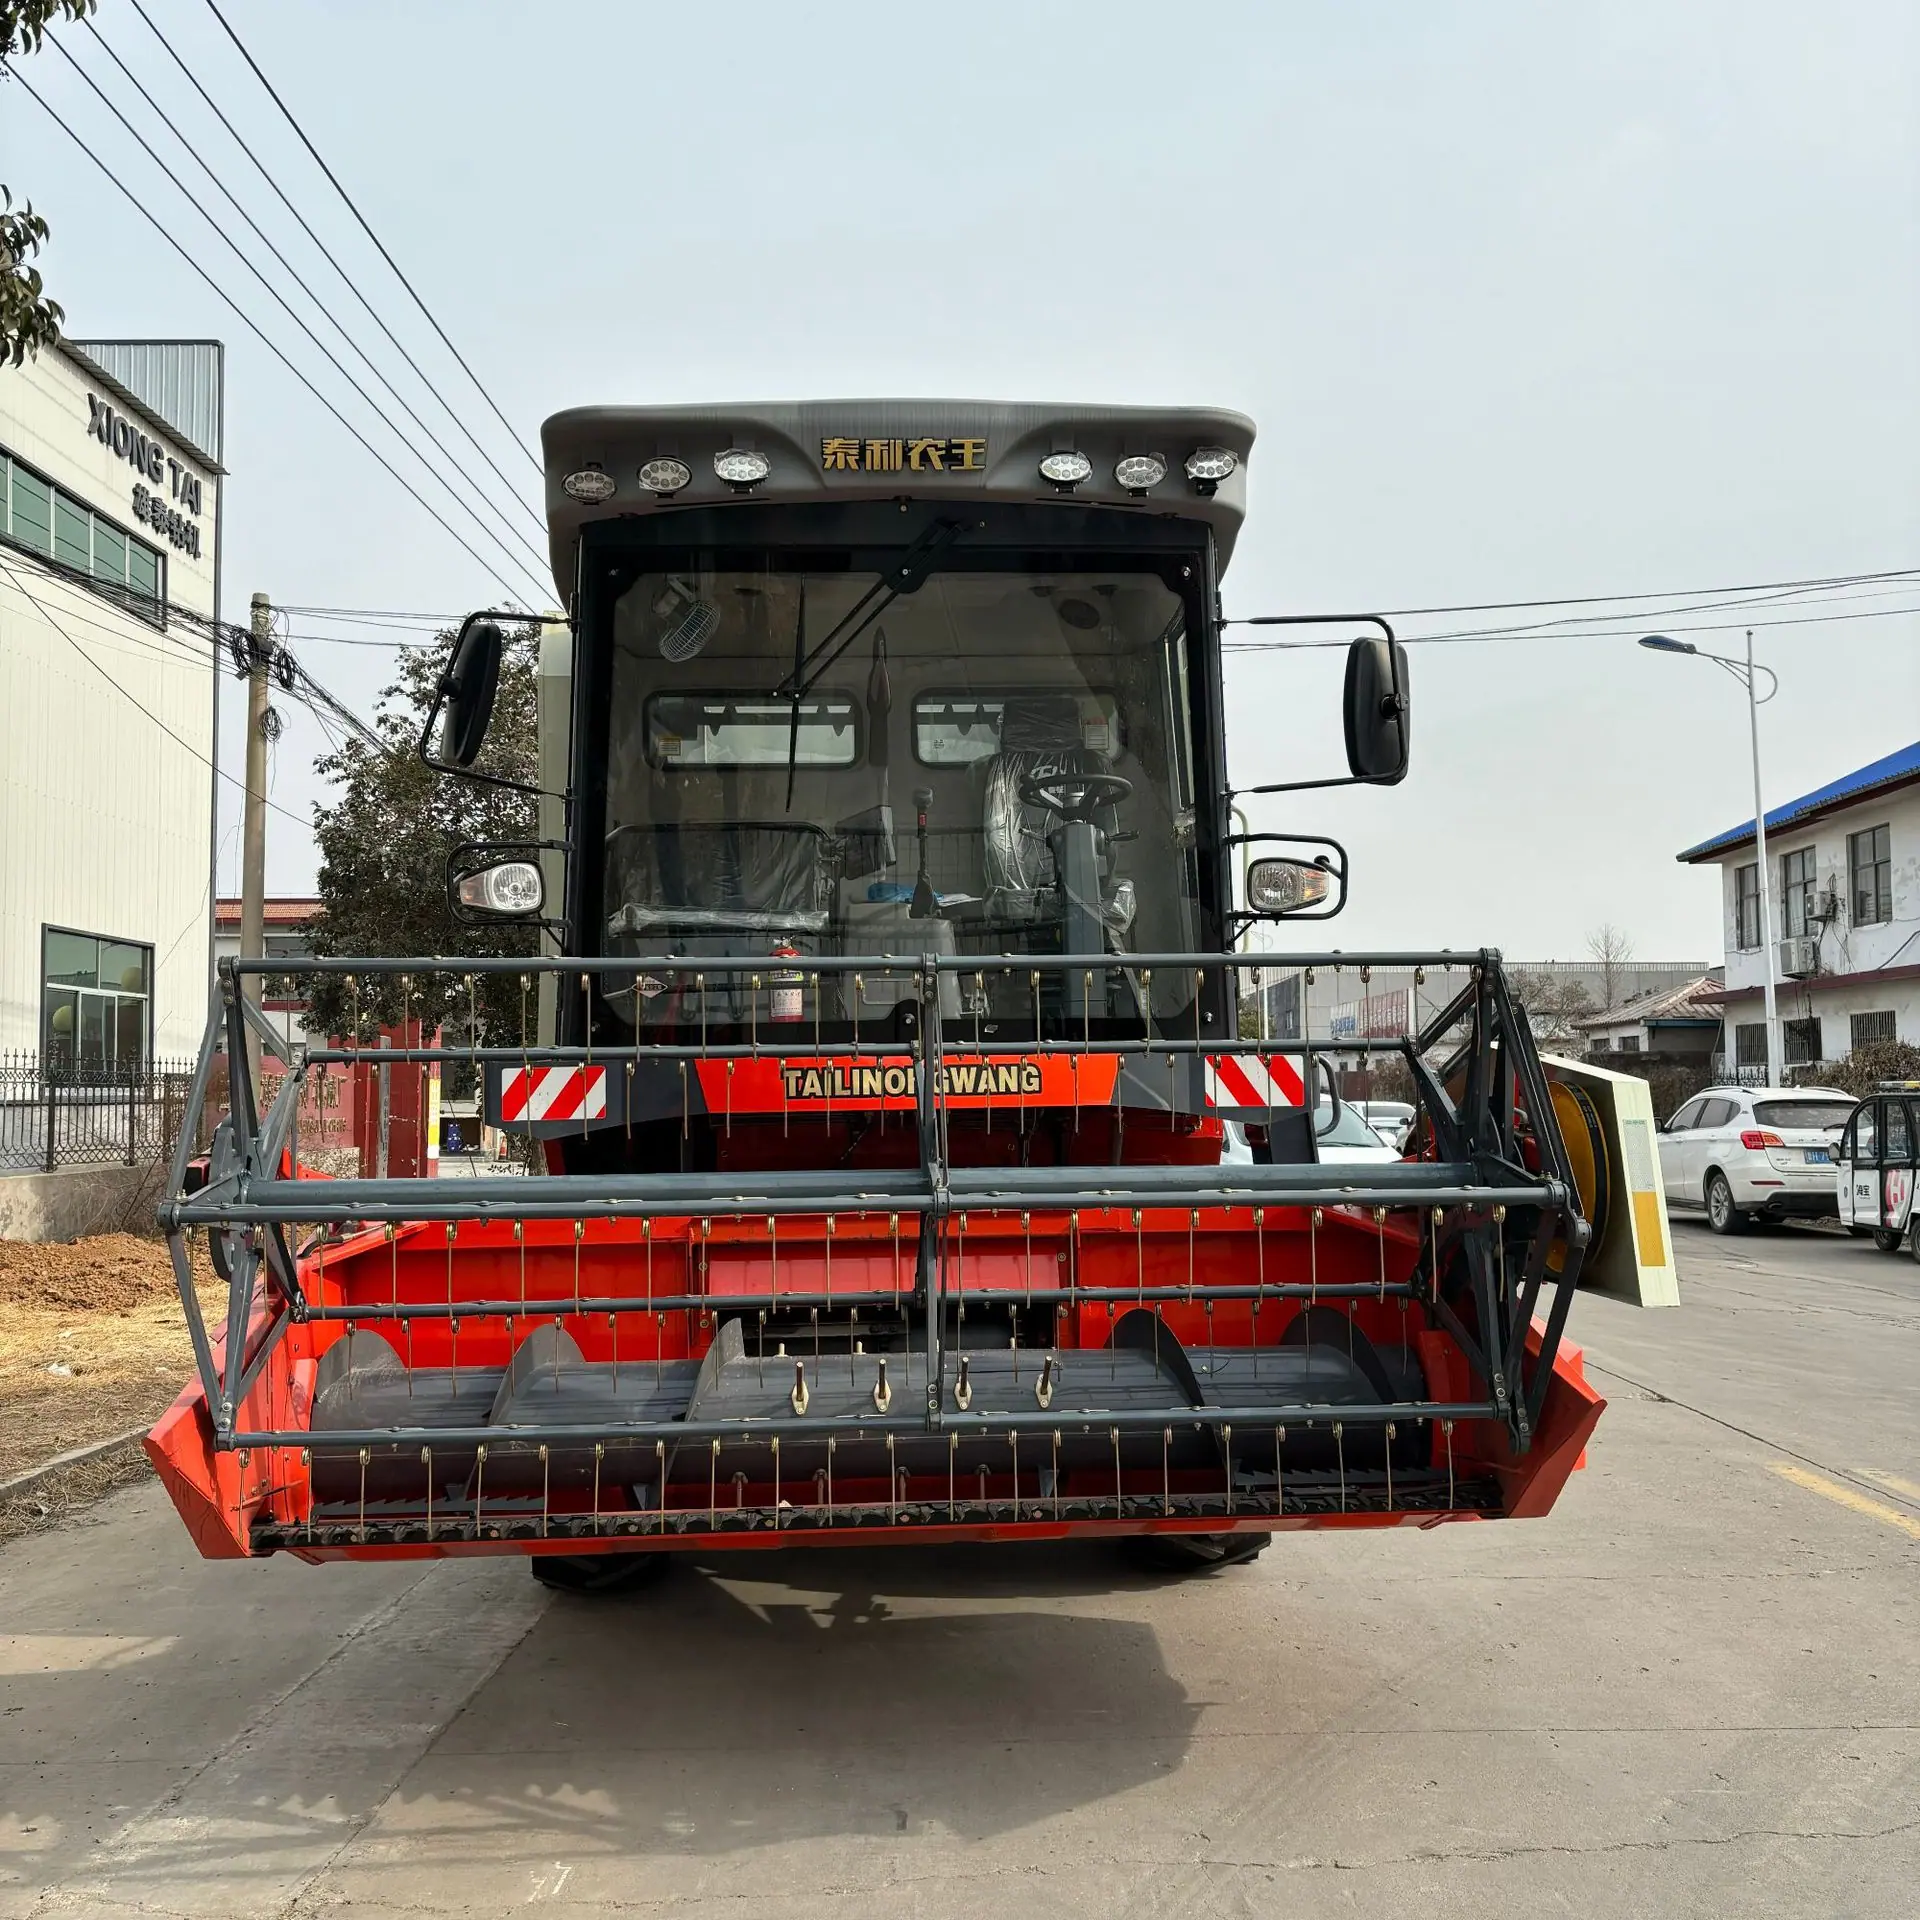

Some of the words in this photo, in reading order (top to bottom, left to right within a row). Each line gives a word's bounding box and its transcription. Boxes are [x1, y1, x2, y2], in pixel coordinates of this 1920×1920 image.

[87, 393, 164, 483] XIONG
[167, 457, 202, 516] TAI
[822, 437, 986, 470] 泰利农王
